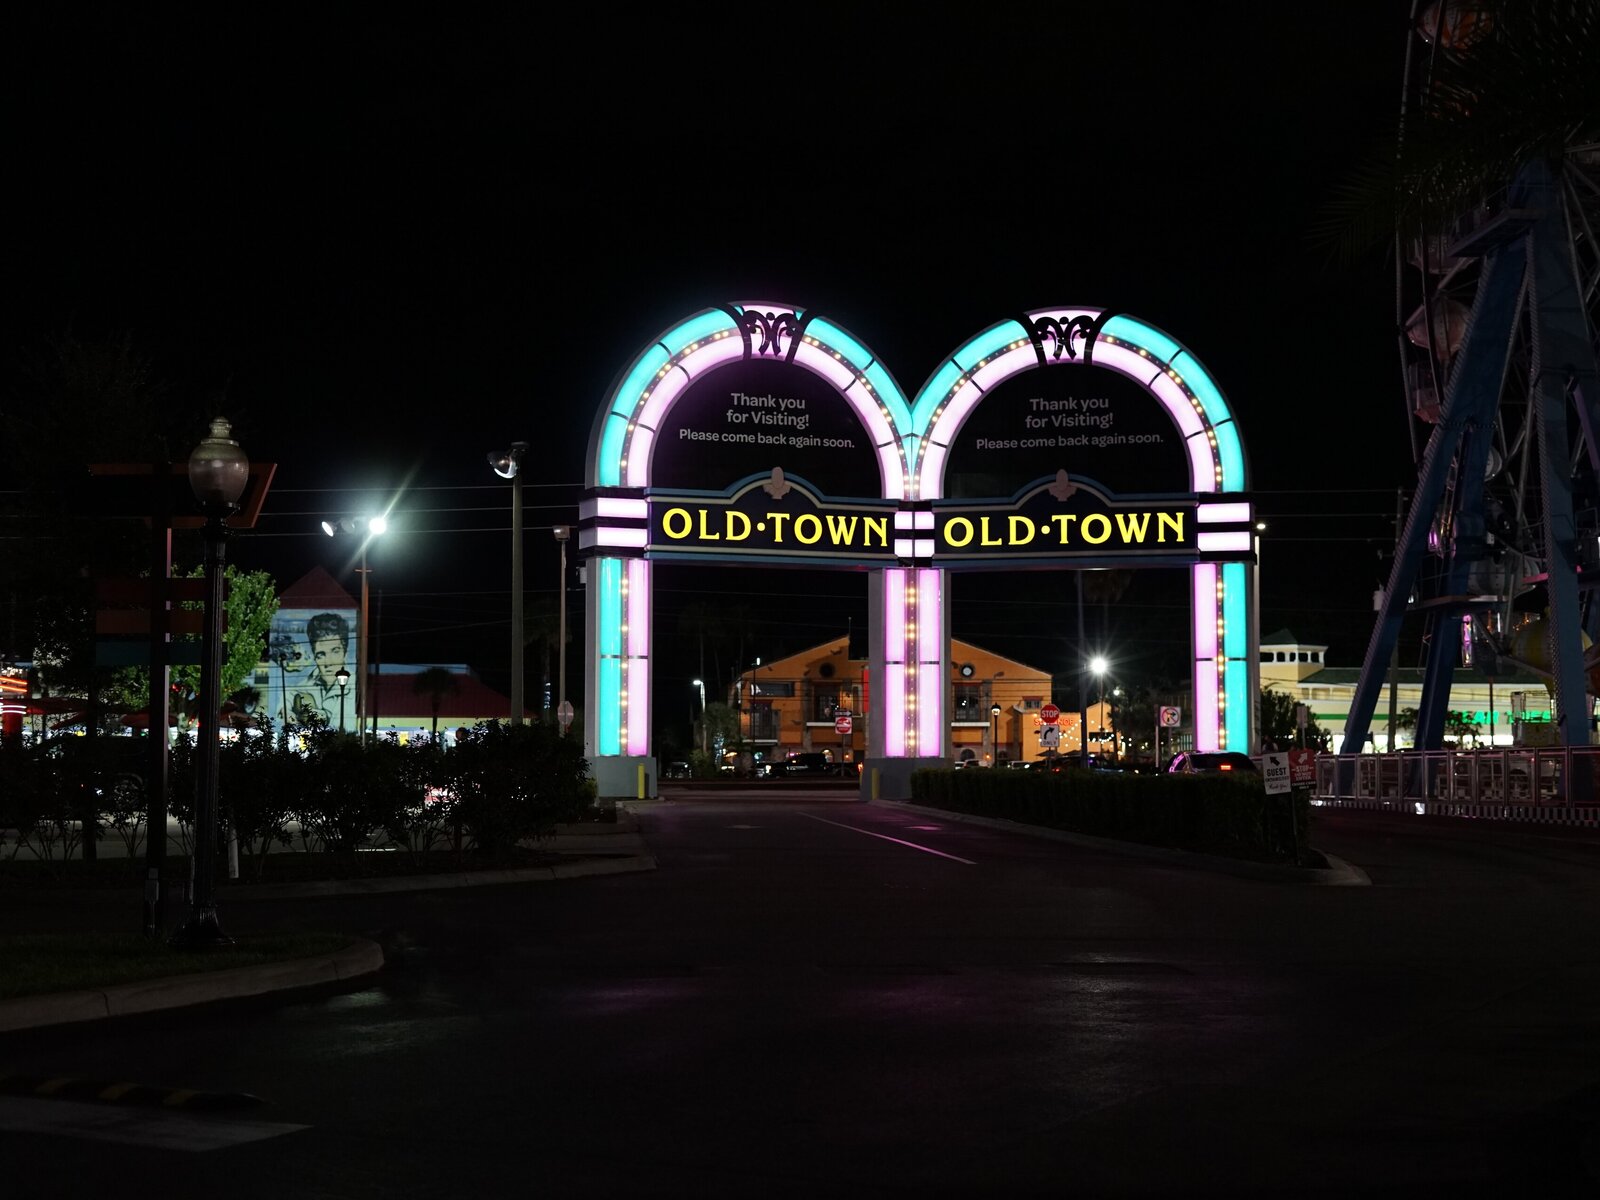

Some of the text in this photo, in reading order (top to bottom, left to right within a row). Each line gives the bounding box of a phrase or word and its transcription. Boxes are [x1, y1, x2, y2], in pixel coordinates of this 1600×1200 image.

[731, 393, 806, 411] Thank you
[1029, 397, 1109, 412] Thank you
[726, 409, 809, 430] for Visiting!
[1025, 412, 1113, 429] for Visiting!
[679, 429, 855, 448] Please come back again soon.
[976, 433, 1164, 450] Please come back again soon.
[1041, 709, 1058, 718] STOP
[1266, 767, 1286, 777] GUEST
